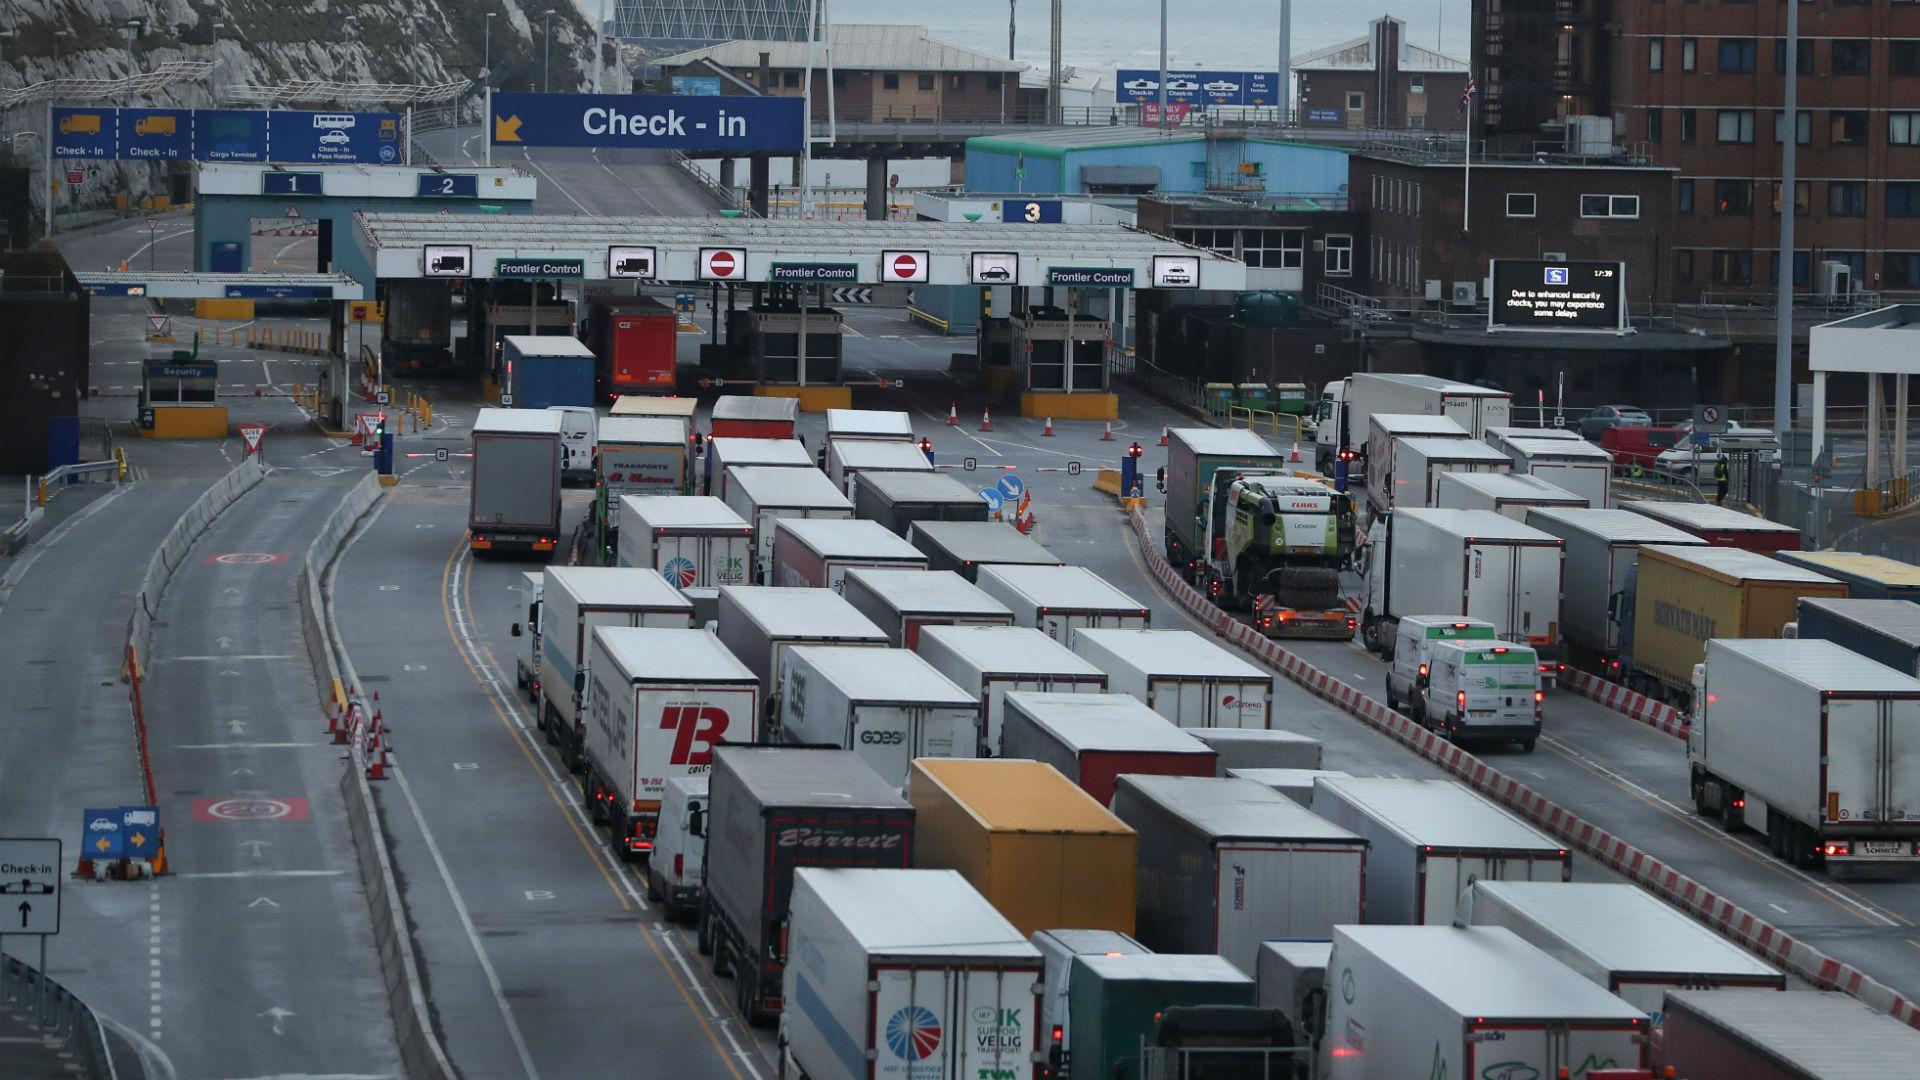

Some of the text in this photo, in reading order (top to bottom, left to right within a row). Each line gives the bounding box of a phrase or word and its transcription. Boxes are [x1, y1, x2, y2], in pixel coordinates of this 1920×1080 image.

[583, 107, 686, 136] Check
[718, 109, 746, 137] in
[55, 146, 85, 156] Check
[94, 146, 104, 156] In
[130, 147, 160, 157] Check
[168, 148, 178, 157] In
[210, 151, 230, 159] Cargo
[288, 175, 298, 192] 1
[442, 178, 455, 194] 2
[1024, 203, 1041, 222] 3
[500, 264, 581, 274] Frontier Control
[775, 267, 855, 278] Frontier Control
[1051, 272, 1131, 283] Frontier Control
[1511, 290, 1601, 300] Due to enhanced security
[1507, 299, 1605, 310] checks, you may experience
[1555, 309, 1578, 319] delays
[163, 367, 202, 378] Security
[716, 572, 743, 580] VELIG
[1233, 699, 1263, 709] Girteka
[777, 827, 902, 849] Barrett
[1, 863, 52, 875] Check-in
[999, 1008, 1022, 1027] IK
[976, 1036, 1022, 1047] VELIG
